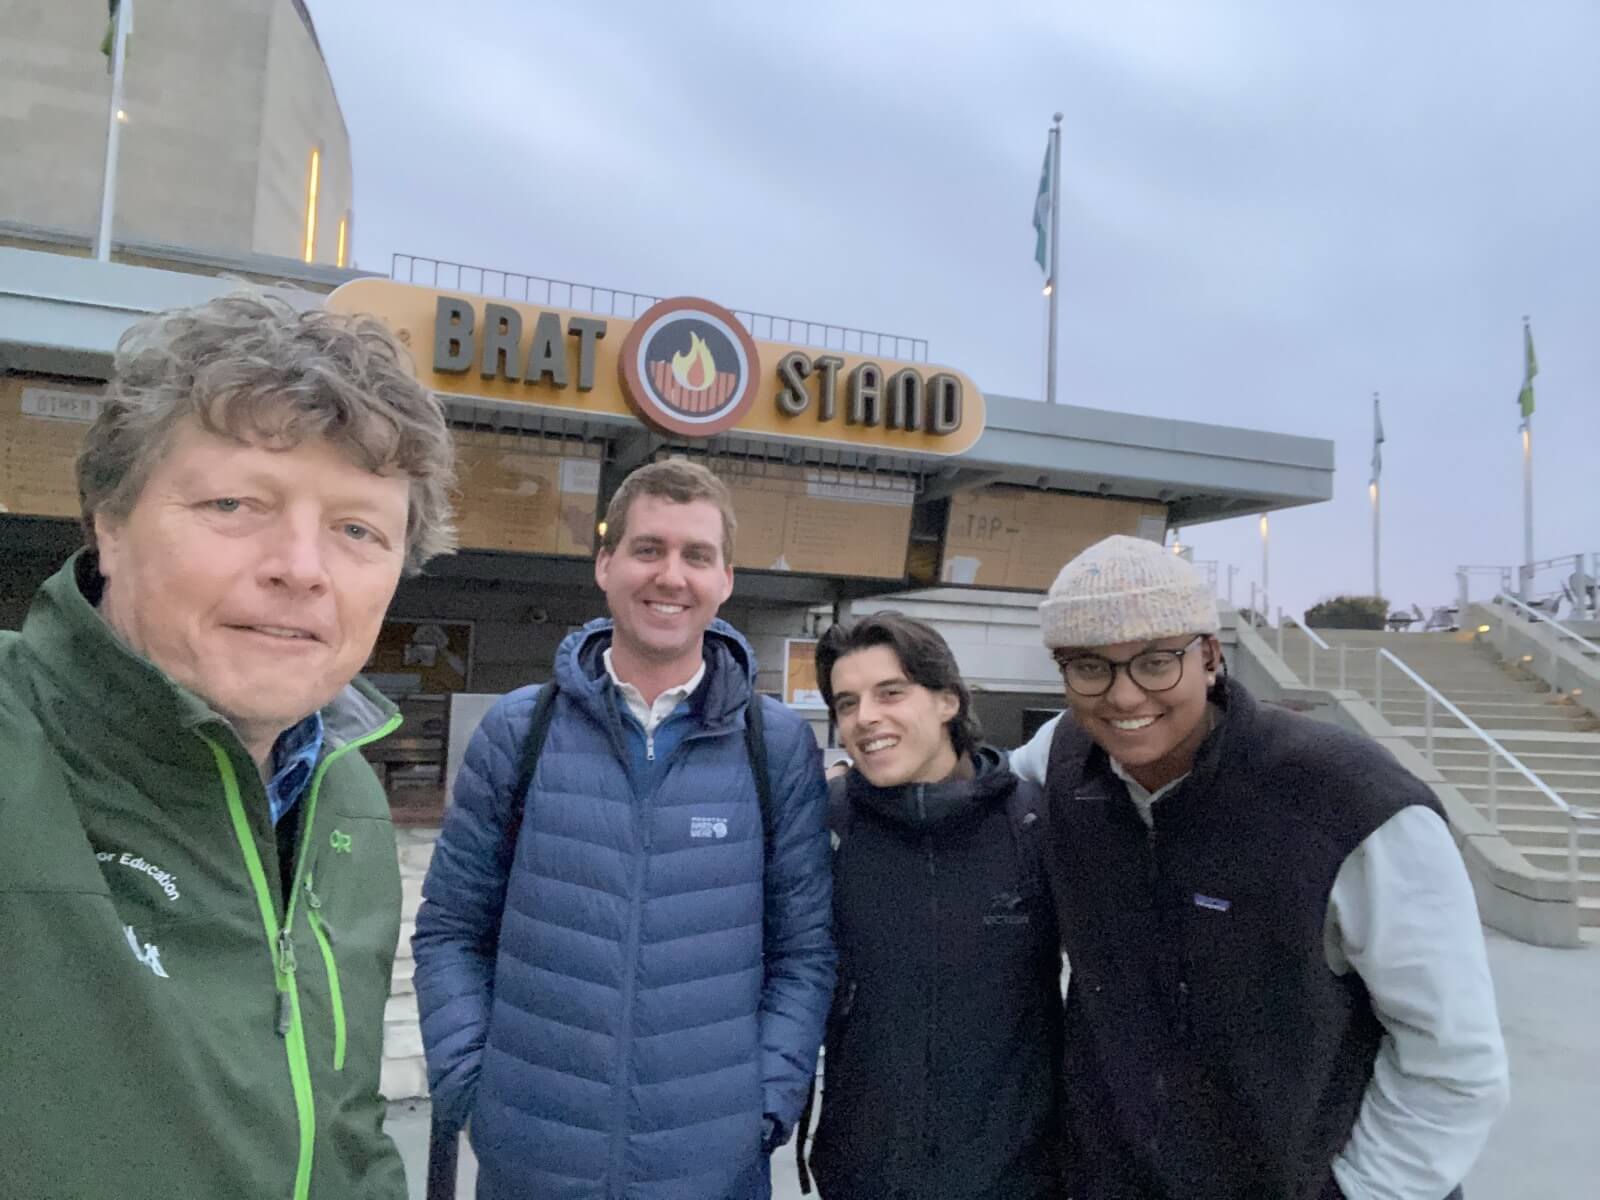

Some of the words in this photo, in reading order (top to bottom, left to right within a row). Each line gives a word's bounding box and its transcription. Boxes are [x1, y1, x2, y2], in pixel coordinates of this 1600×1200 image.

[433, 296, 607, 392] BRAT
[776, 350, 964, 434] STAND
[119, 852, 180, 901] Education
